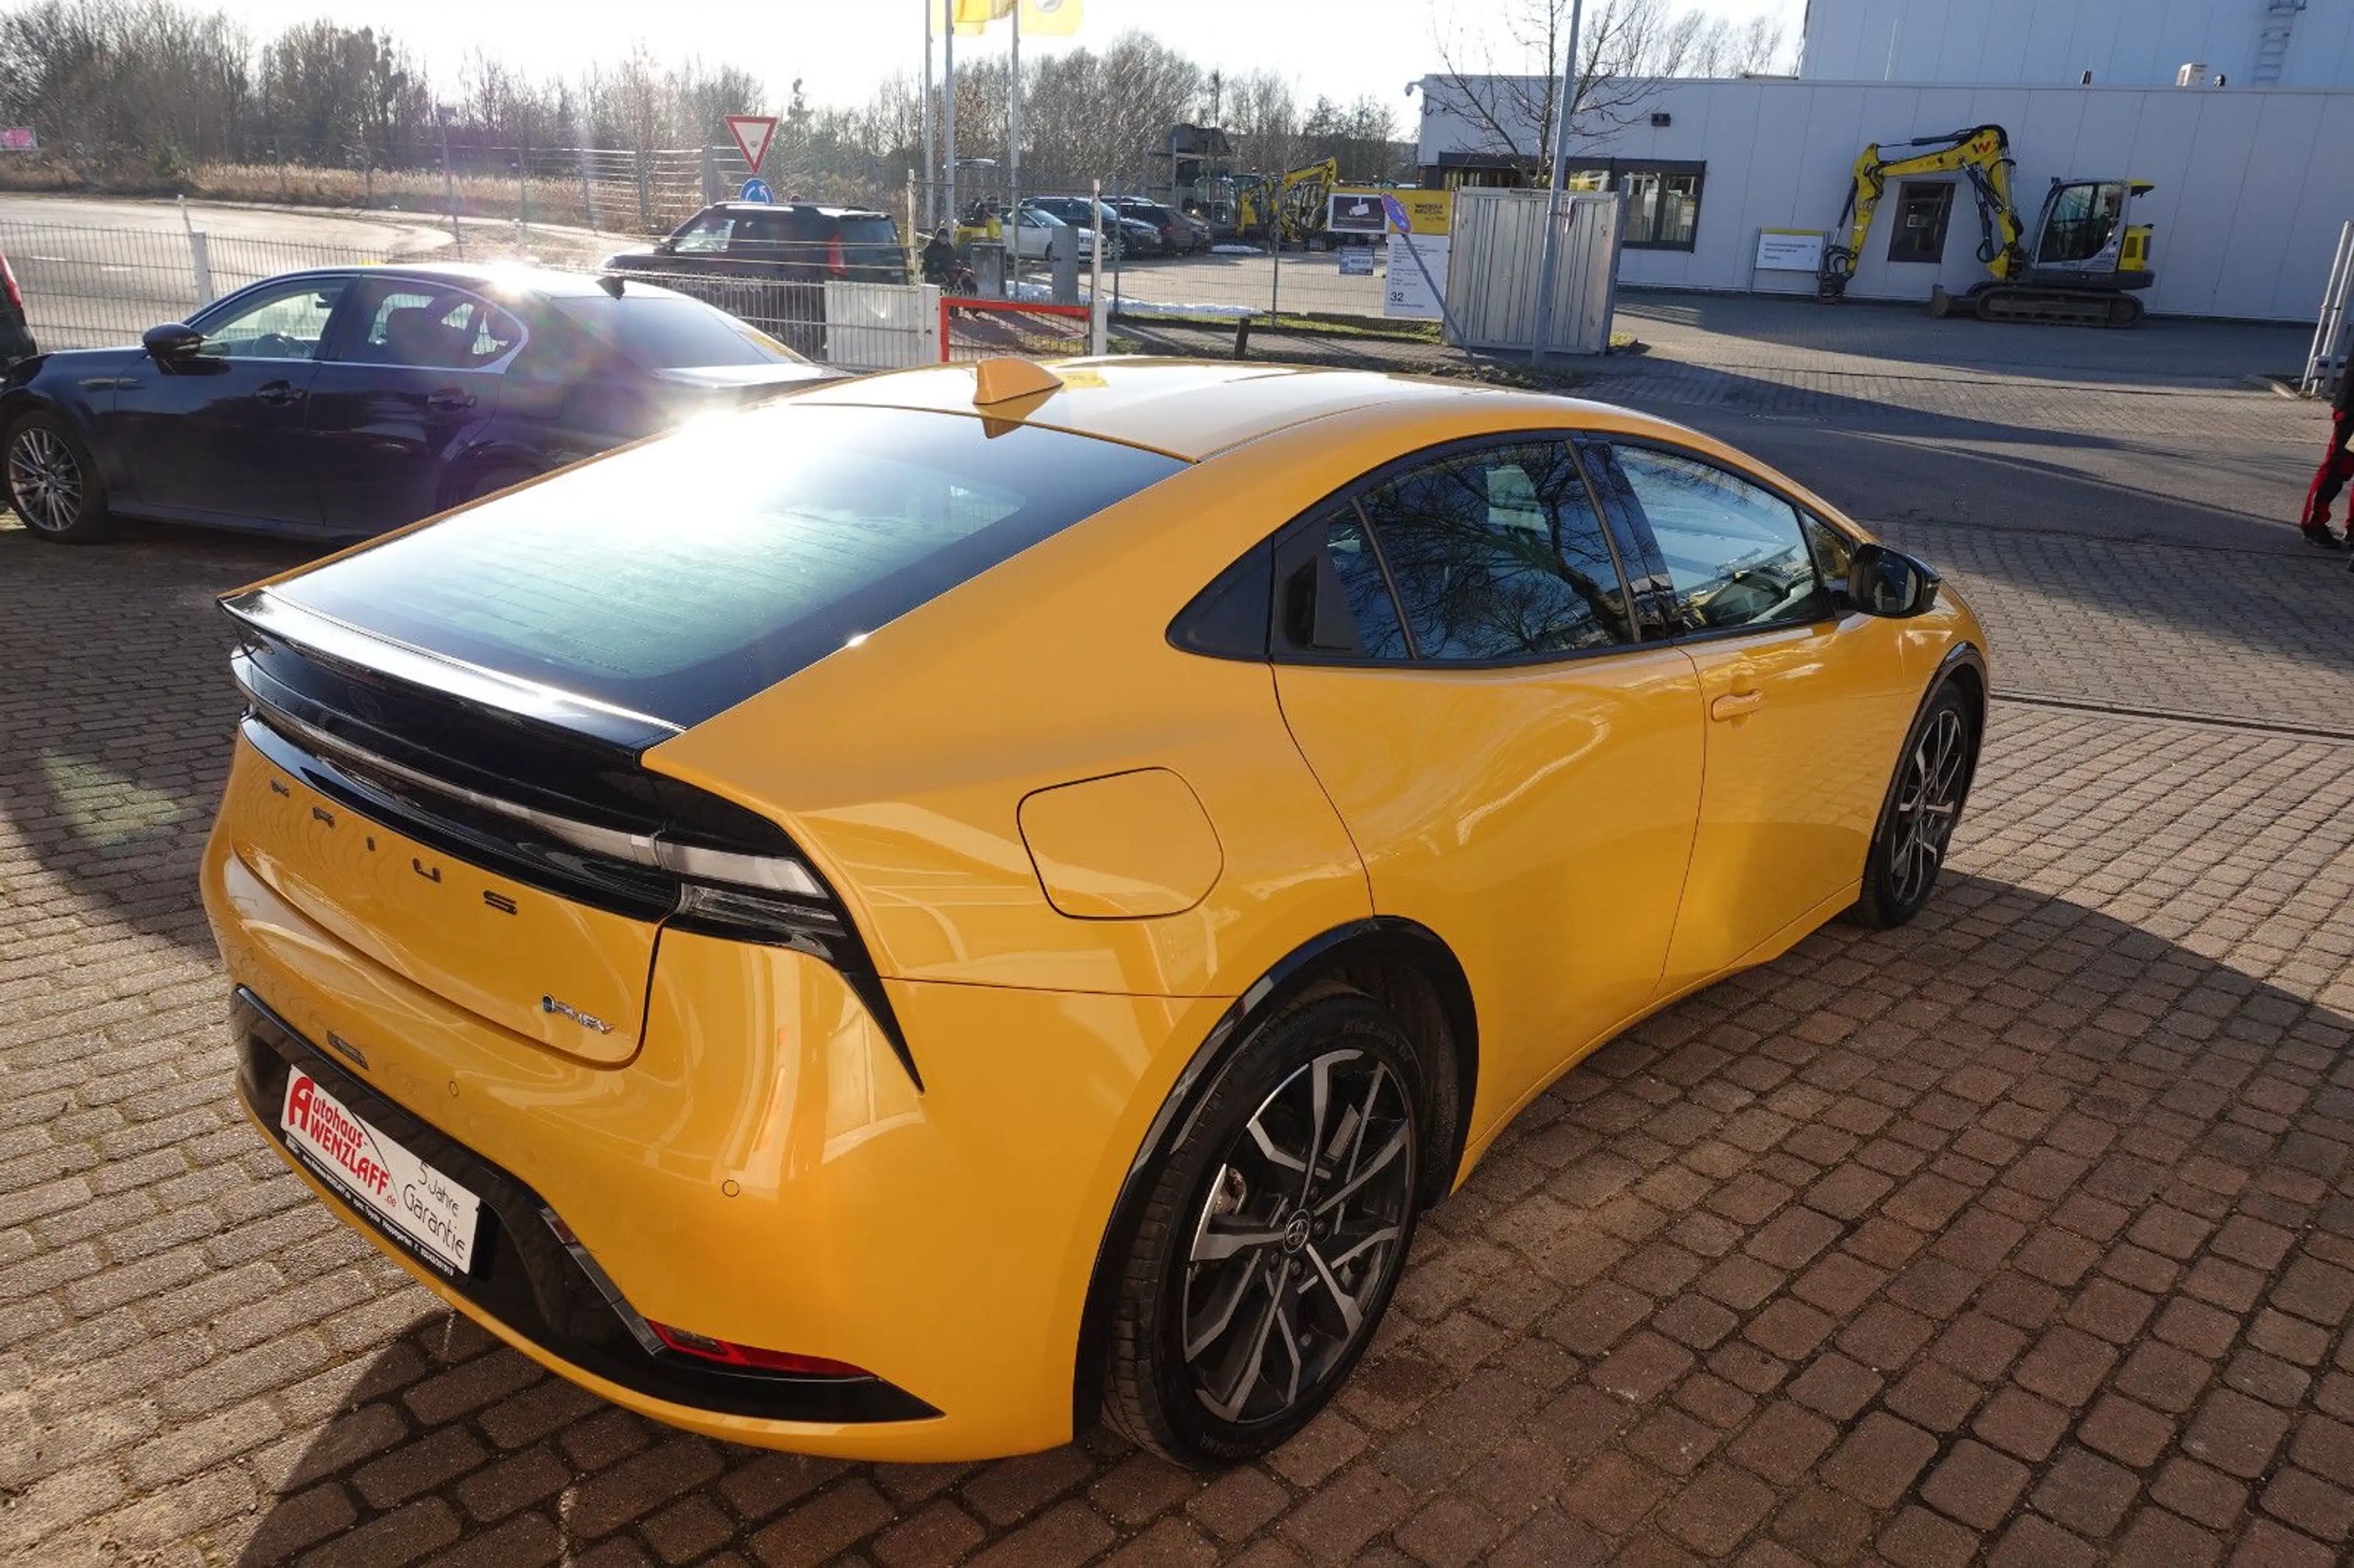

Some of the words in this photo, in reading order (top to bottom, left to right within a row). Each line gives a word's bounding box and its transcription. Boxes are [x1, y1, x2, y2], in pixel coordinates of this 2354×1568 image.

[1390, 291, 1404, 302] 32
[271, 777, 518, 915] PRIUS
[403, 1184, 466, 1261] Garantie
[417, 1162, 429, 1186] 5
[429, 1179, 459, 1218] Jahre
